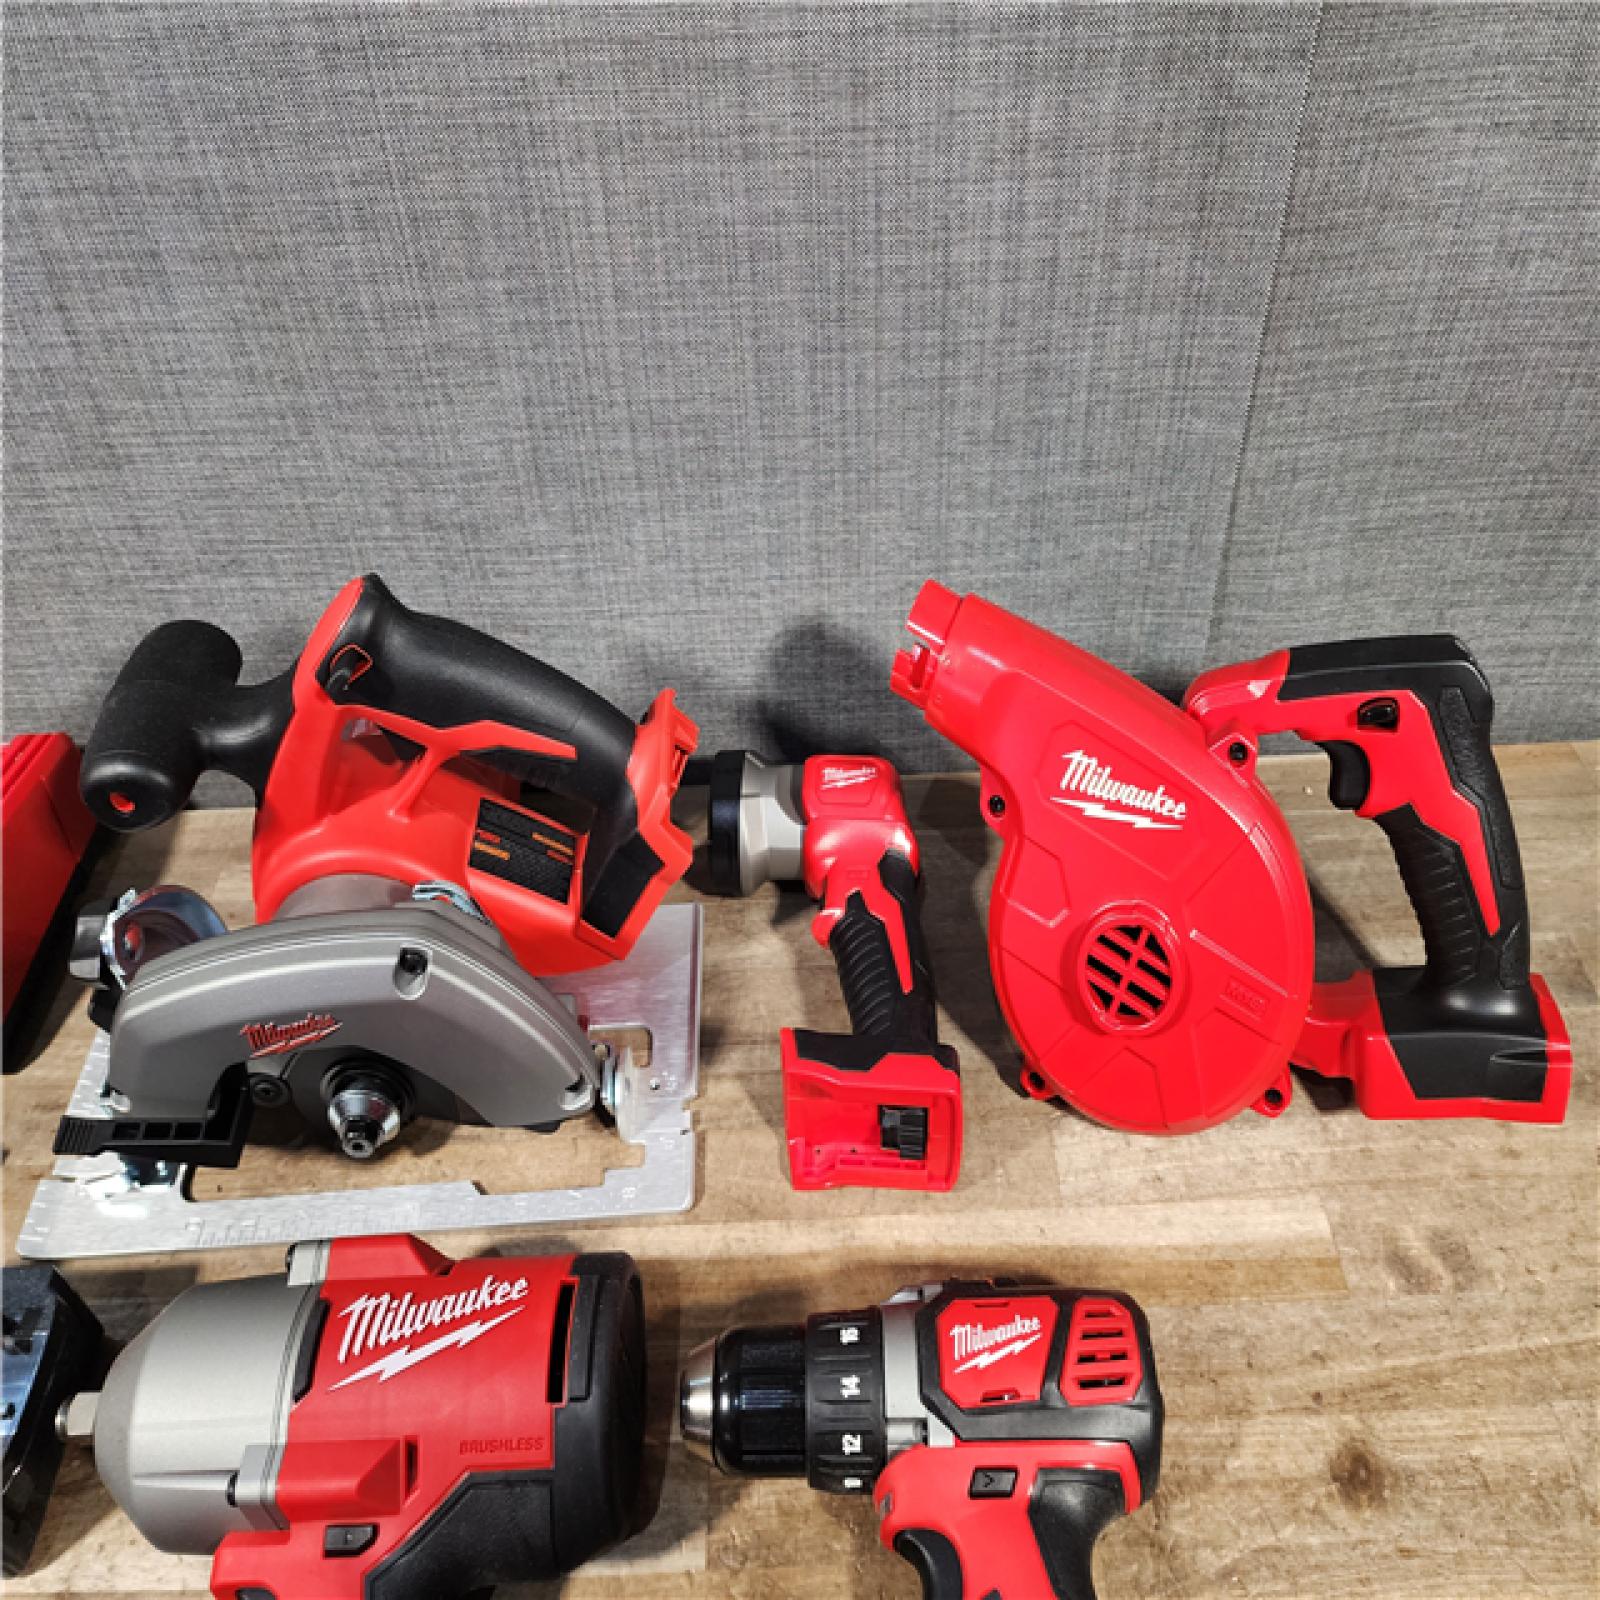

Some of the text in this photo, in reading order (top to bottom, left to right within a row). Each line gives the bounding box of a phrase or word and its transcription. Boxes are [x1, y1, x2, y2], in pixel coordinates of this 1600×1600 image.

[1061, 750, 1186, 819] Milwaukee
[337, 1275, 529, 1364] Milwaukee
[950, 1314, 1041, 1360] Milwaukee
[840, 1375, 860, 1398] 14
[459, 1436, 544, 1455] BRUSHLESS
[841, 1434, 862, 1455] 12
